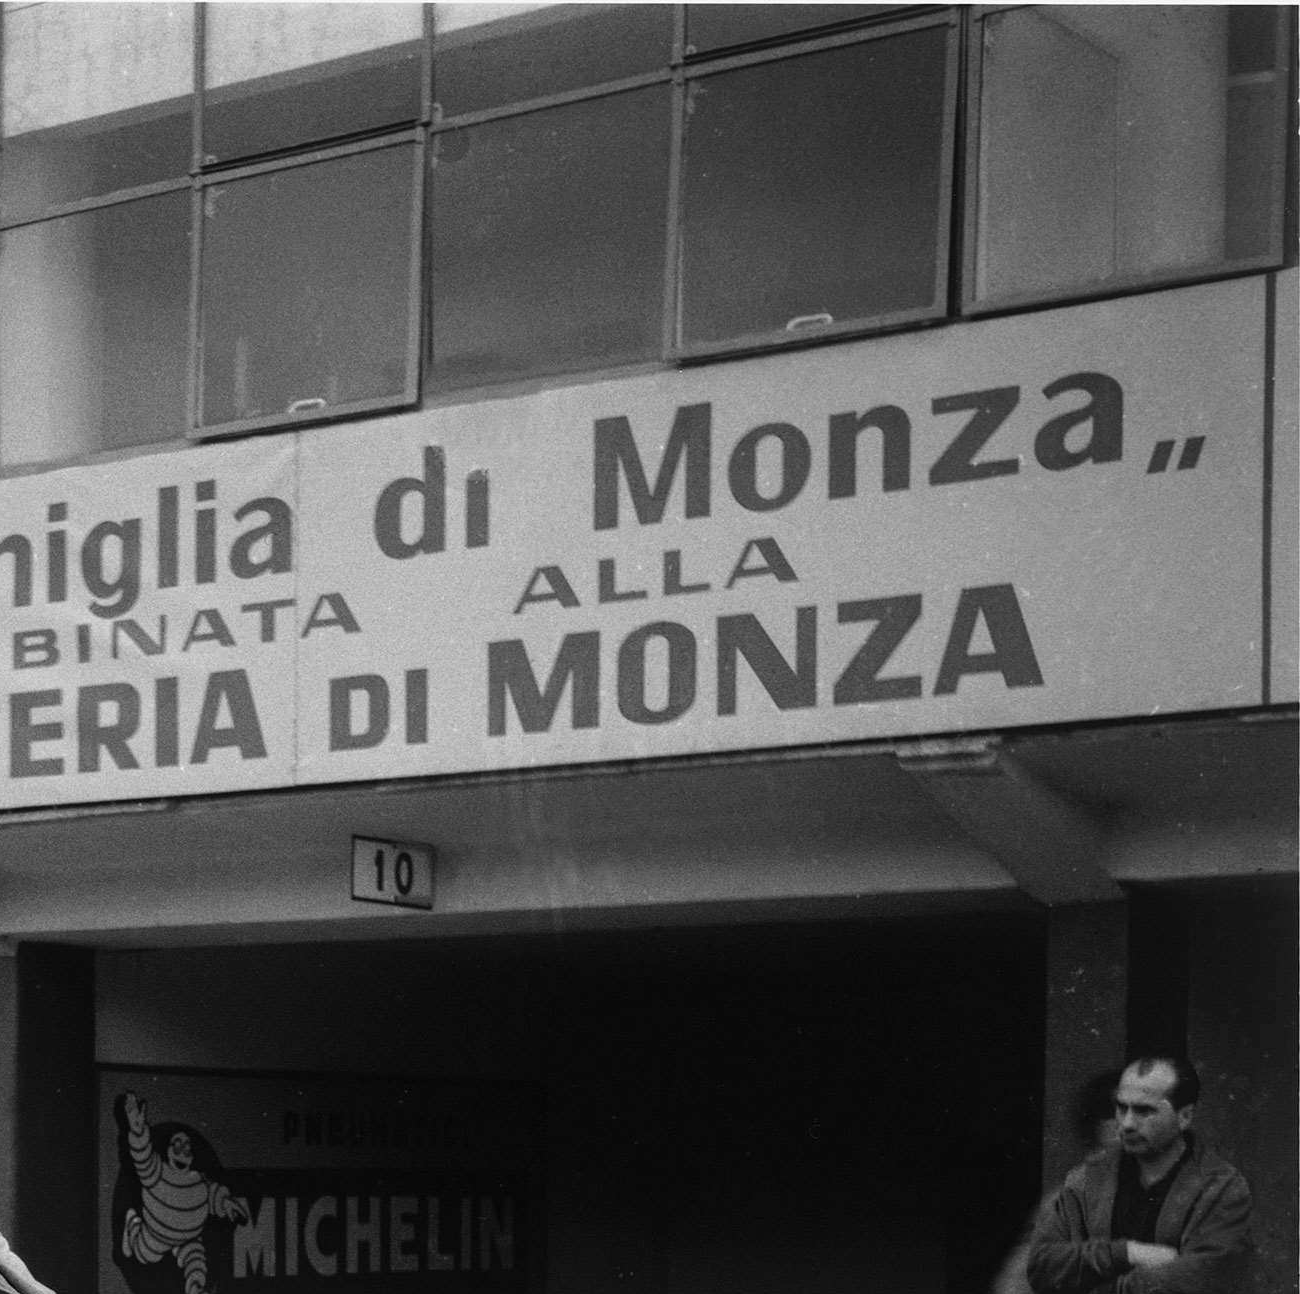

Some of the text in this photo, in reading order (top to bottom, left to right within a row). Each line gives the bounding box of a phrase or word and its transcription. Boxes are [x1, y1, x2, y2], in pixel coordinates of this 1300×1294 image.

[374, 446, 489, 560] di
[513, 535, 799, 615] ALLA
[329, 668, 428, 752] DI
[486, 582, 1044, 737] MONZA
[374, 849, 414, 896] 10
[232, 1194, 515, 1279] MICHELIN
